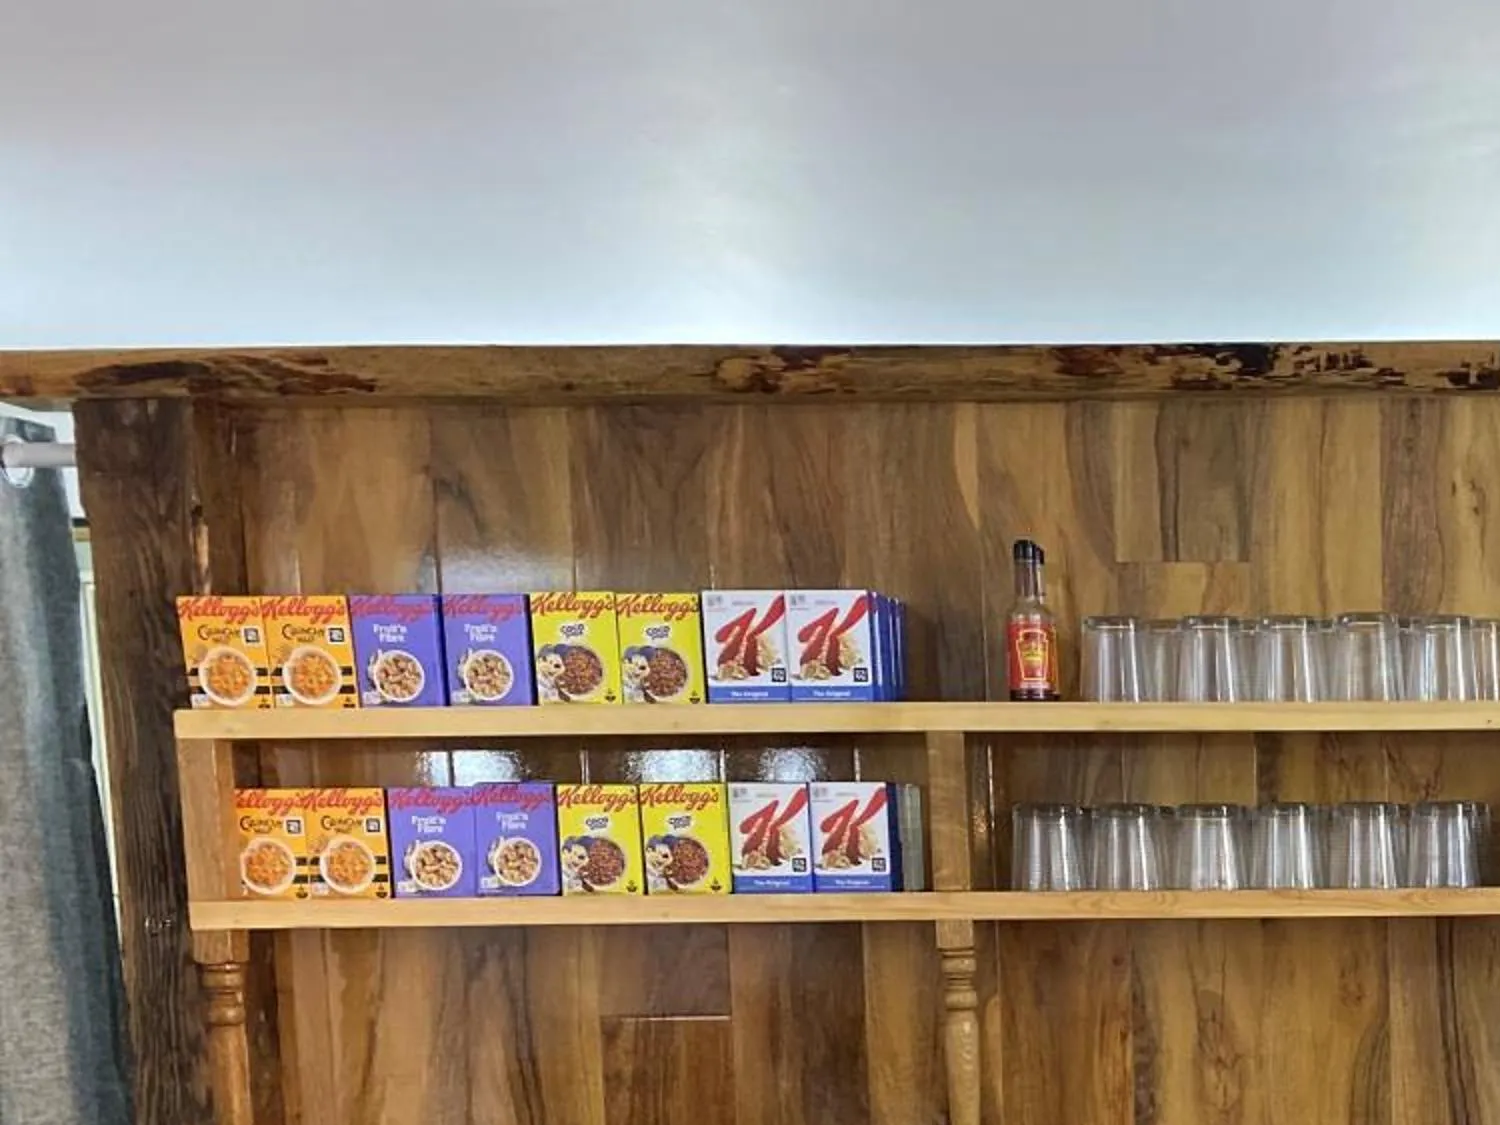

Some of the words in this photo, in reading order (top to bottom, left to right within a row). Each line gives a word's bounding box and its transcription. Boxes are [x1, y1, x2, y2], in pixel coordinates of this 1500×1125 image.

[262, 595, 346, 624] Kellogg's
[531, 592, 614, 619] Kellogg's
[616, 593, 699, 621] Kellogg's
[234, 787, 302, 816] ellogg's
[301, 787, 384, 815] Kellogg's
[558, 784, 639, 812] Kellogg's
[639, 784, 719, 810] Kellogg's
